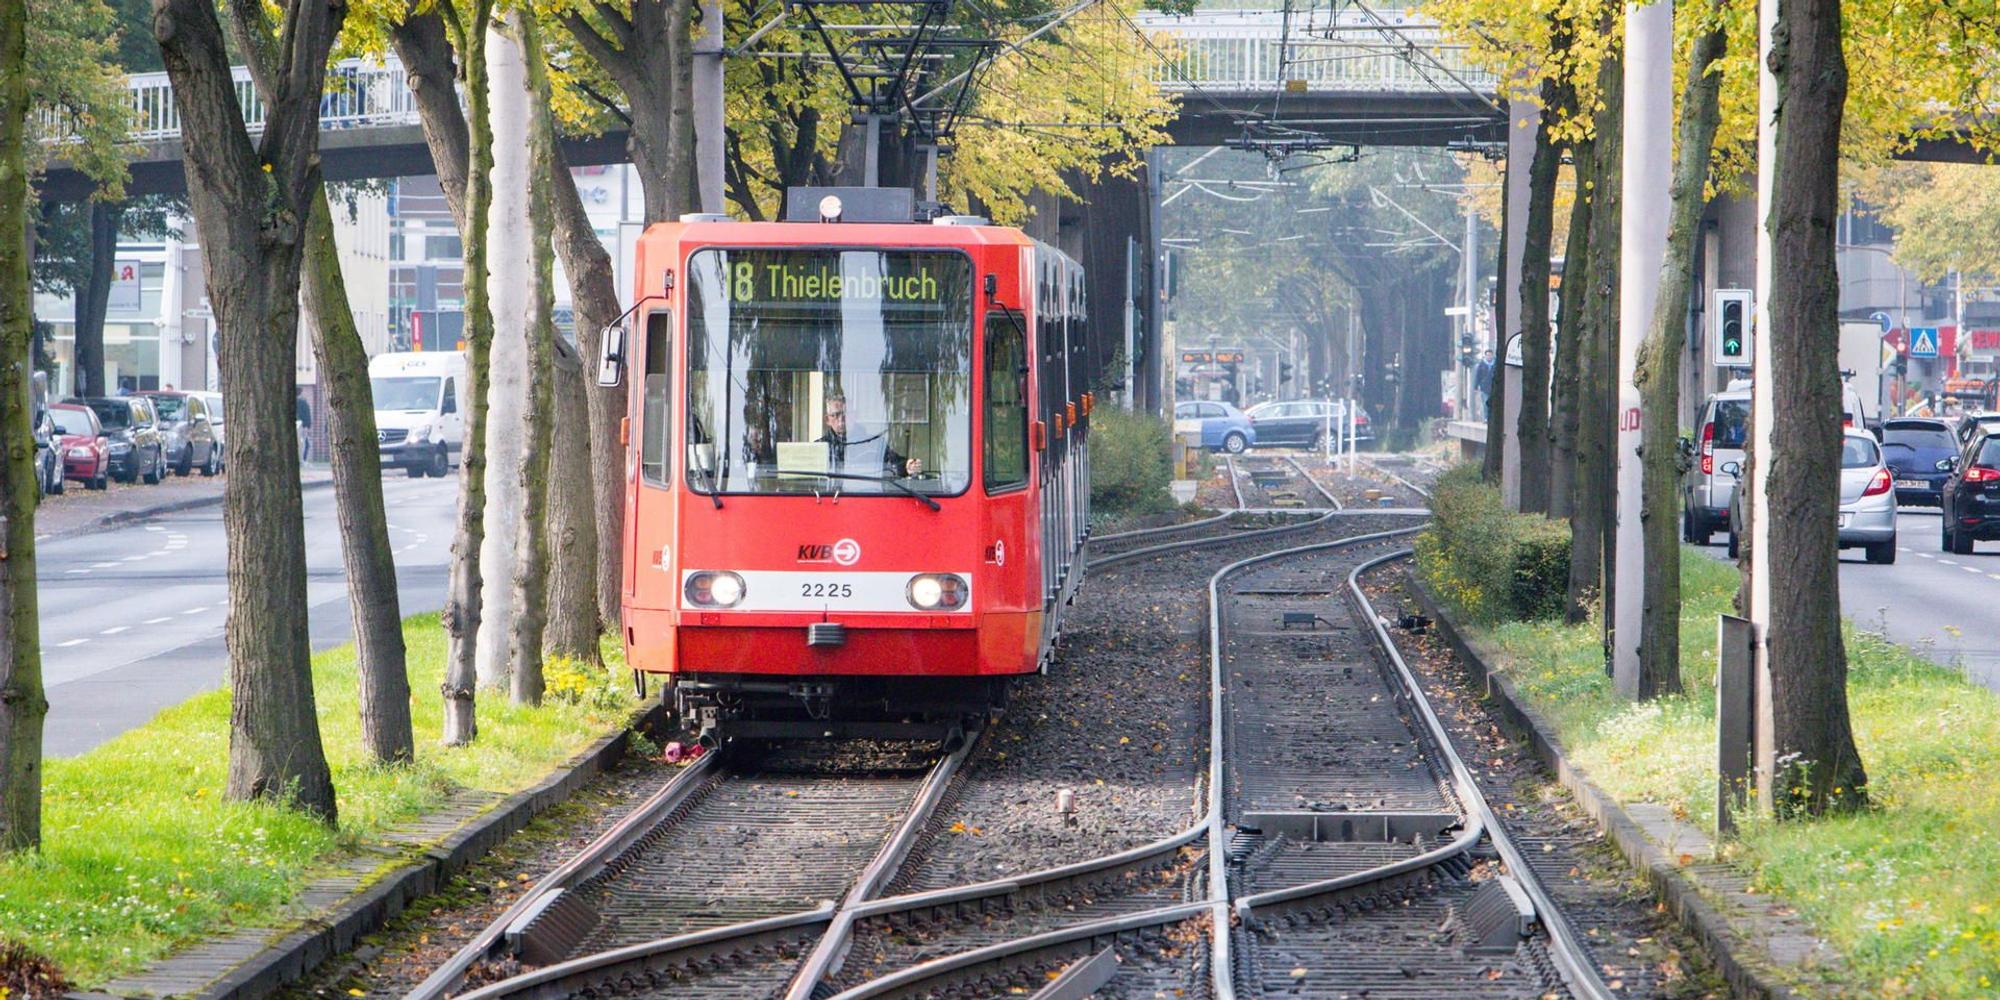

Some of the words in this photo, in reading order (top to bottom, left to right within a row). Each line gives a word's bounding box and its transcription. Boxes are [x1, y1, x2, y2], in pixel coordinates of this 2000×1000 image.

[725, 262, 753, 301] 18
[767, 264, 937, 300] Thielenbruch
[797, 545, 833, 560] KVB
[801, 583, 852, 598] 2225
